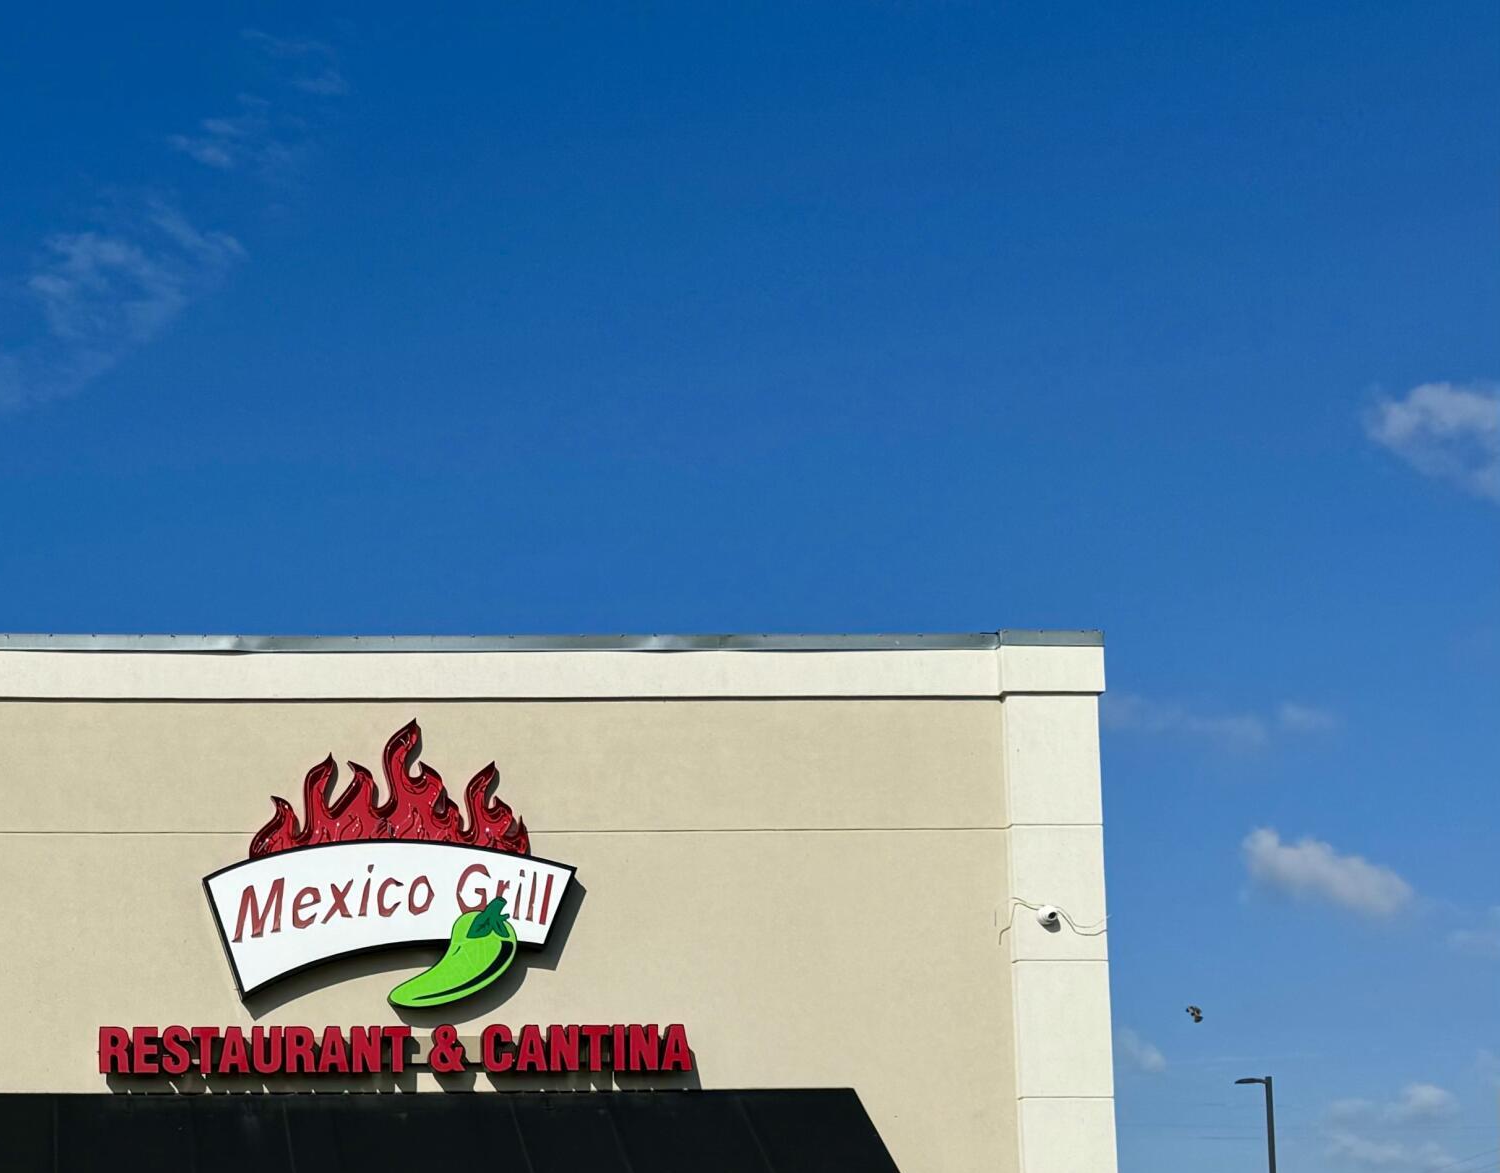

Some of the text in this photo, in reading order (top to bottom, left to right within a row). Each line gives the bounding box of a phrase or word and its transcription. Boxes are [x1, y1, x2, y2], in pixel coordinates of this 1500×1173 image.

[232, 863, 554, 944] Mexico Grill
[99, 1023, 693, 1076] RESTAURANT & CANTINA
